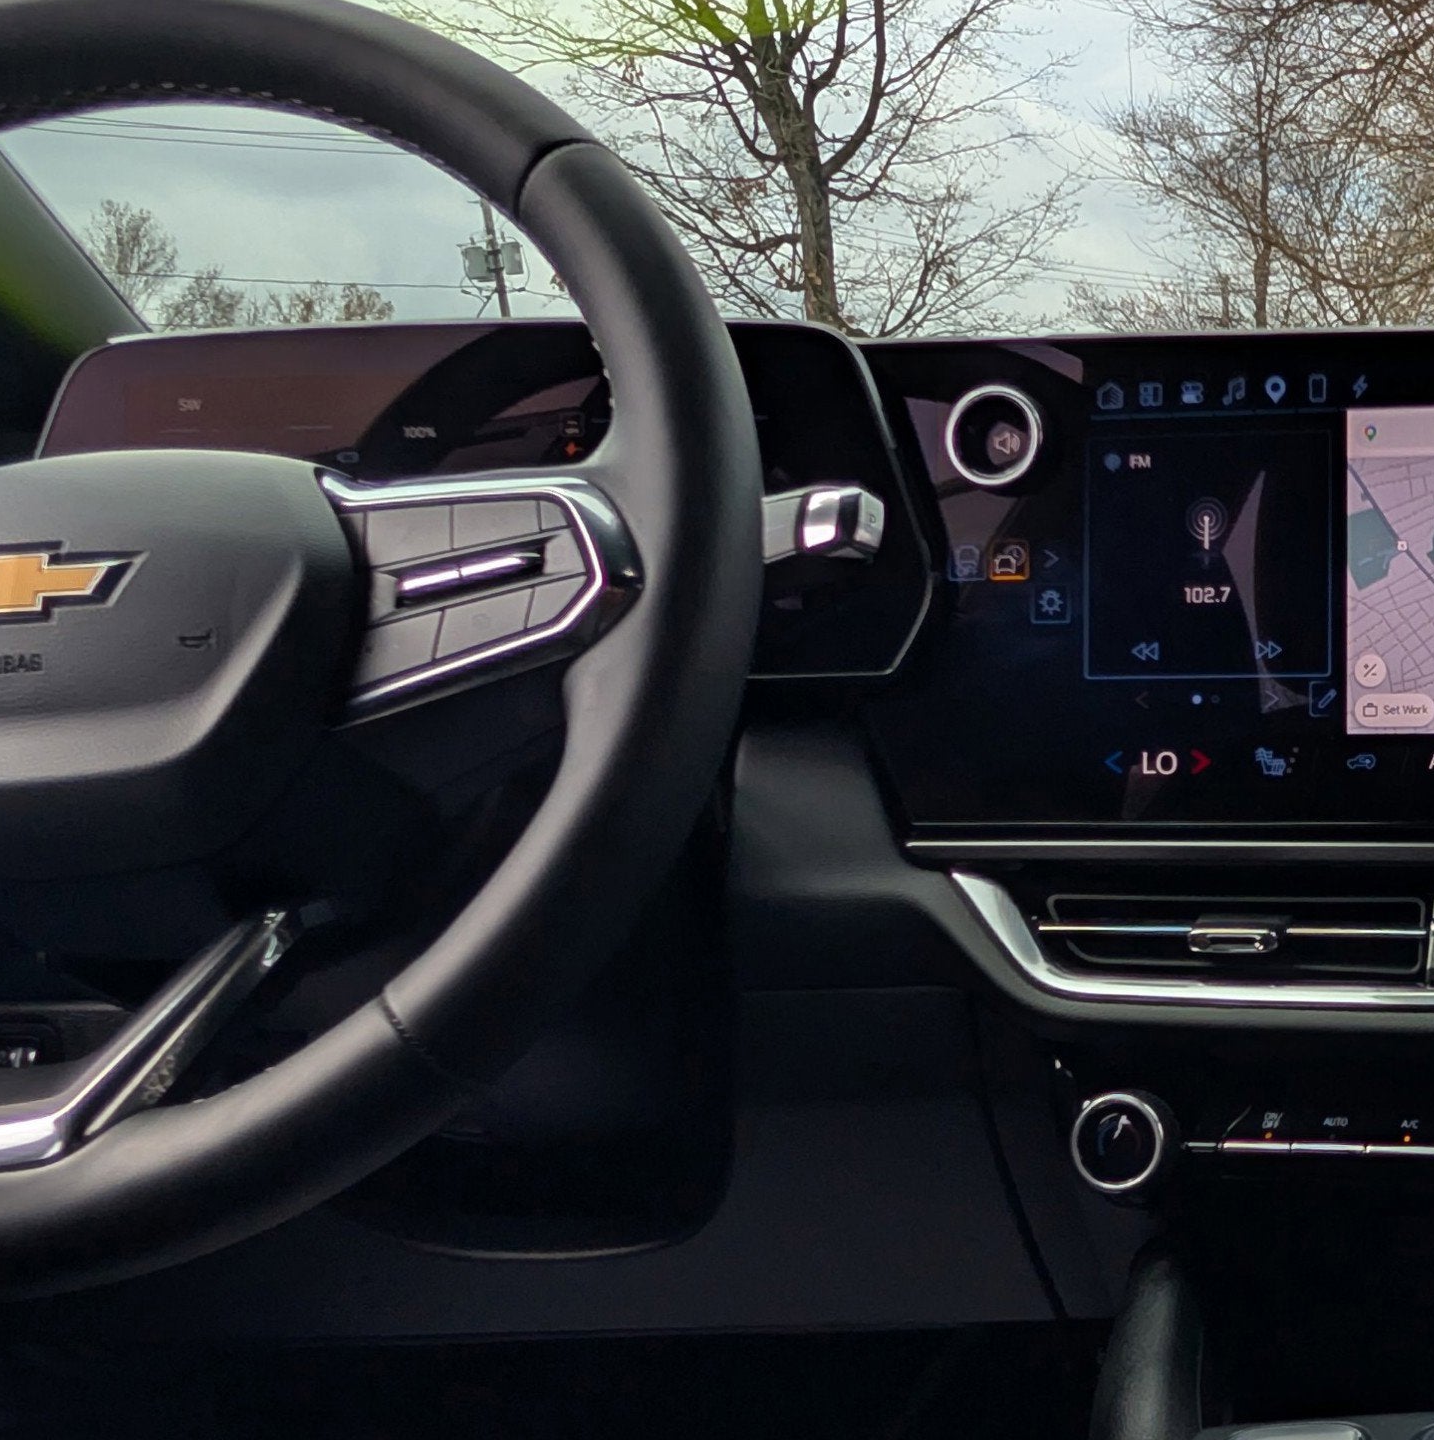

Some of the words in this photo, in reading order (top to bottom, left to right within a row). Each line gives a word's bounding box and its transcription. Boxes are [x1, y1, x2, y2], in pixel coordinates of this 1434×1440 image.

[1128, 453, 1152, 470] FM
[1183, 586, 1232, 604] 102.7
[1382, 704, 1400, 716] Set
[1403, 704, 1429, 716] Work
[1142, 751, 1178, 775] LO
[1323, 1117, 1349, 1127] AUTO
[1400, 1119, 1419, 1129] A/C
